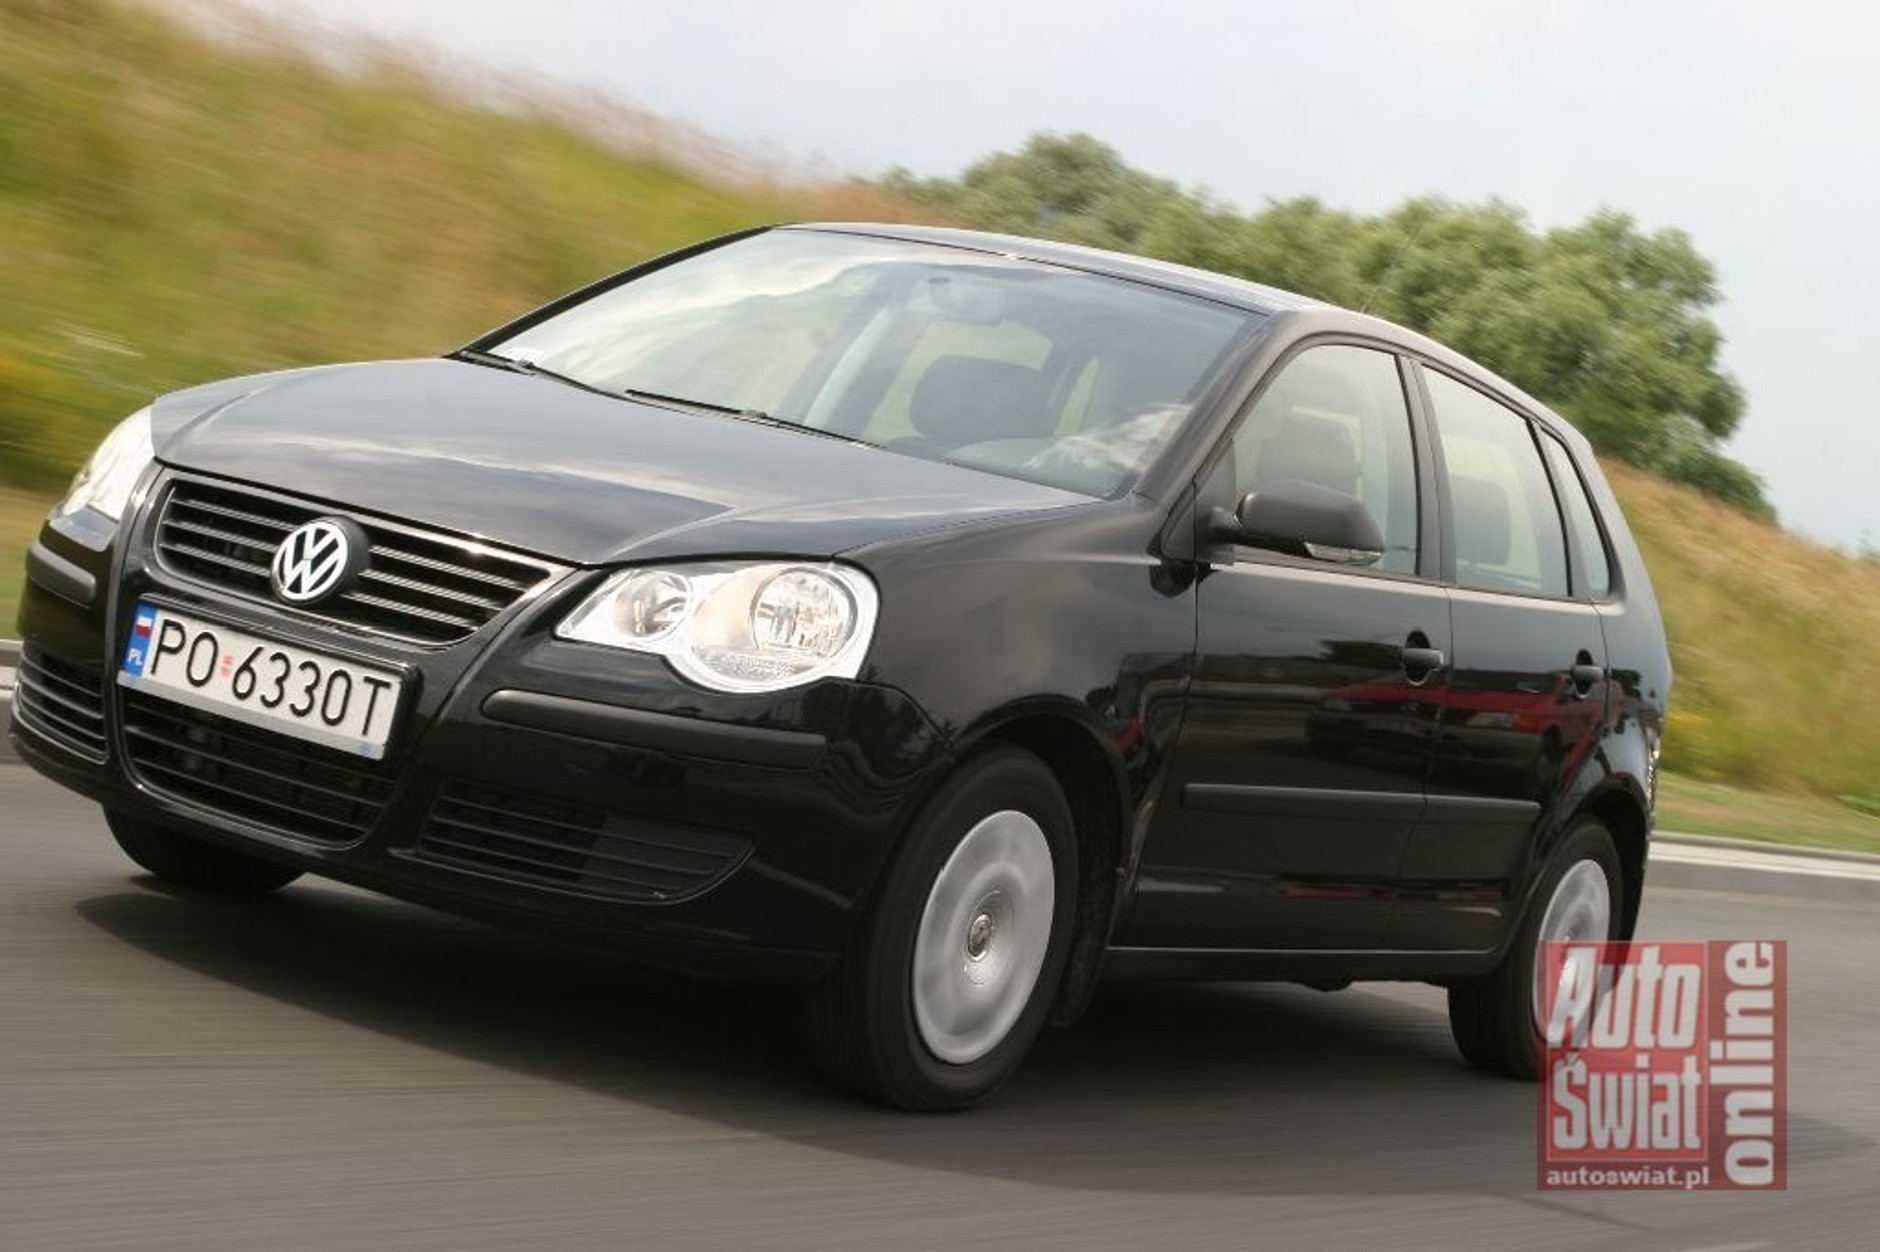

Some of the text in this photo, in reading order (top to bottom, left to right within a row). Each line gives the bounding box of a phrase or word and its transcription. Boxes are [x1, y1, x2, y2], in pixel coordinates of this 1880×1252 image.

[127, 648, 143, 666] PL
[150, 618, 392, 736] PO 6330T
